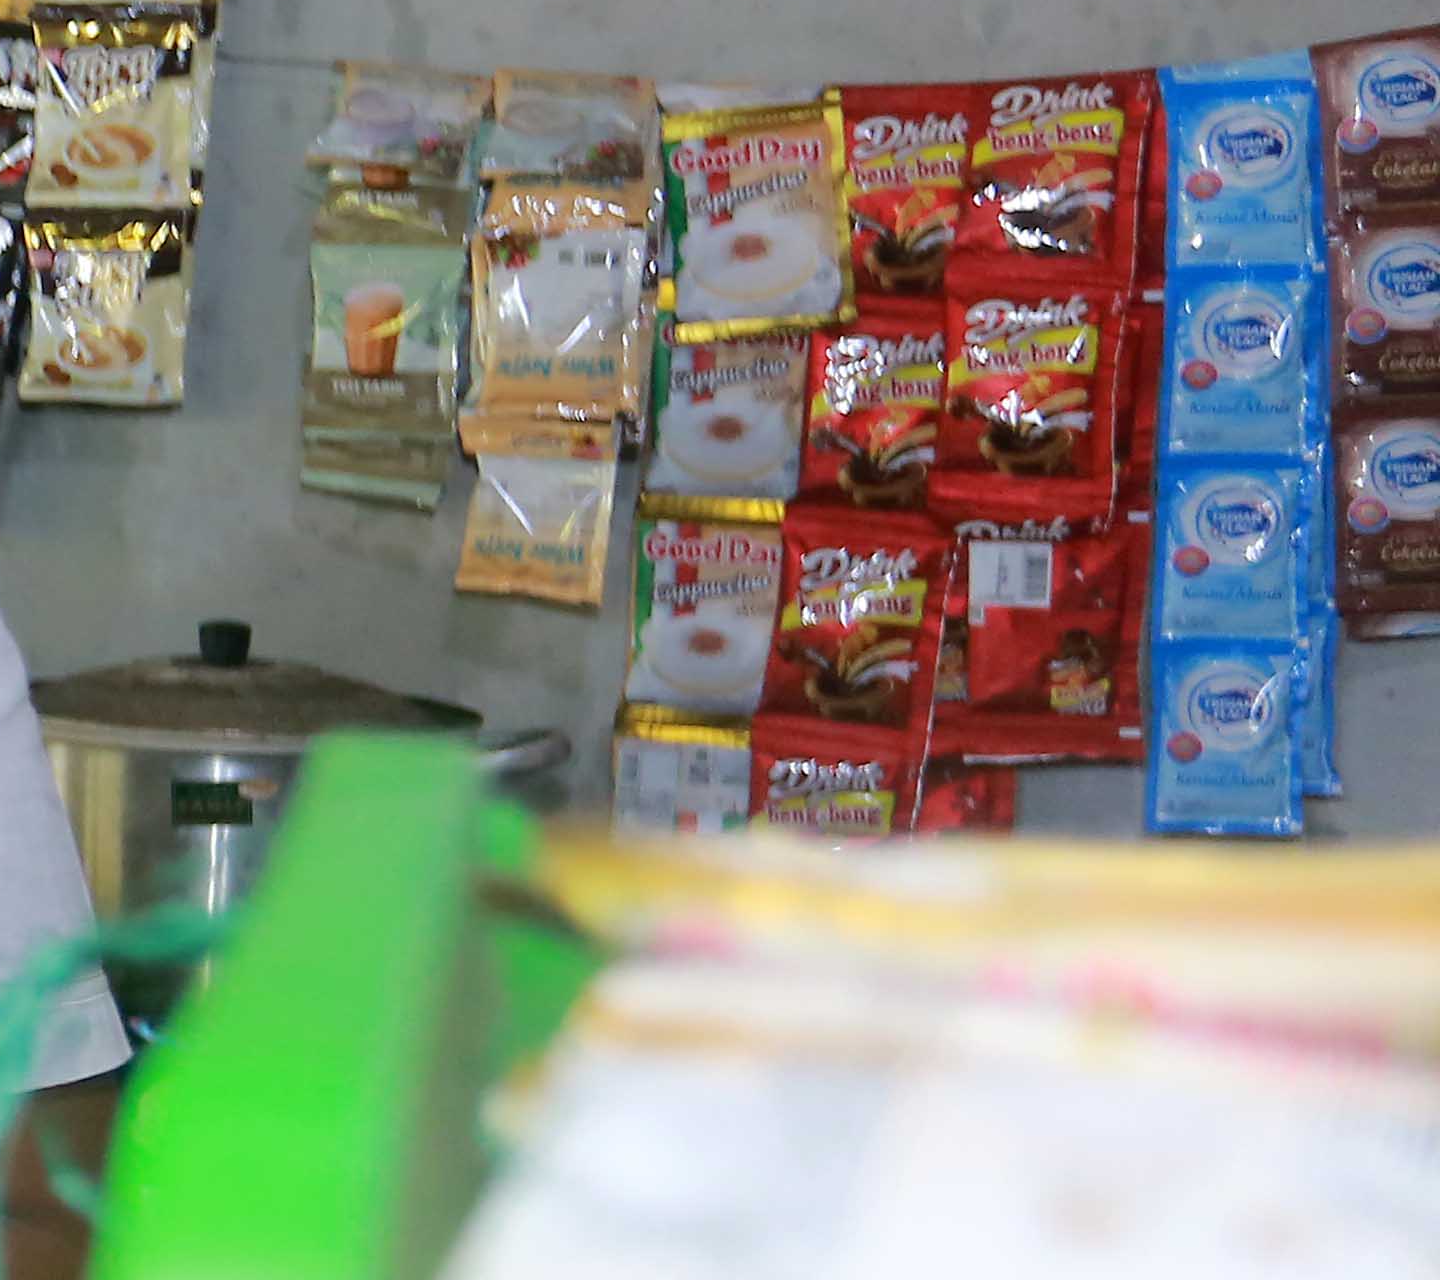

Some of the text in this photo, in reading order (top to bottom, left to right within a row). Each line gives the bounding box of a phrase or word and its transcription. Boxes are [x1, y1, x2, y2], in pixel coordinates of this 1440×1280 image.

[990, 82, 1114, 128] Drink
[670, 136, 824, 176] Good Day
[851, 113, 968, 162] Drink
[987, 120, 1115, 154] beng-beng
[964, 292, 1089, 344] Drink
[645, 530, 723, 566] Good
